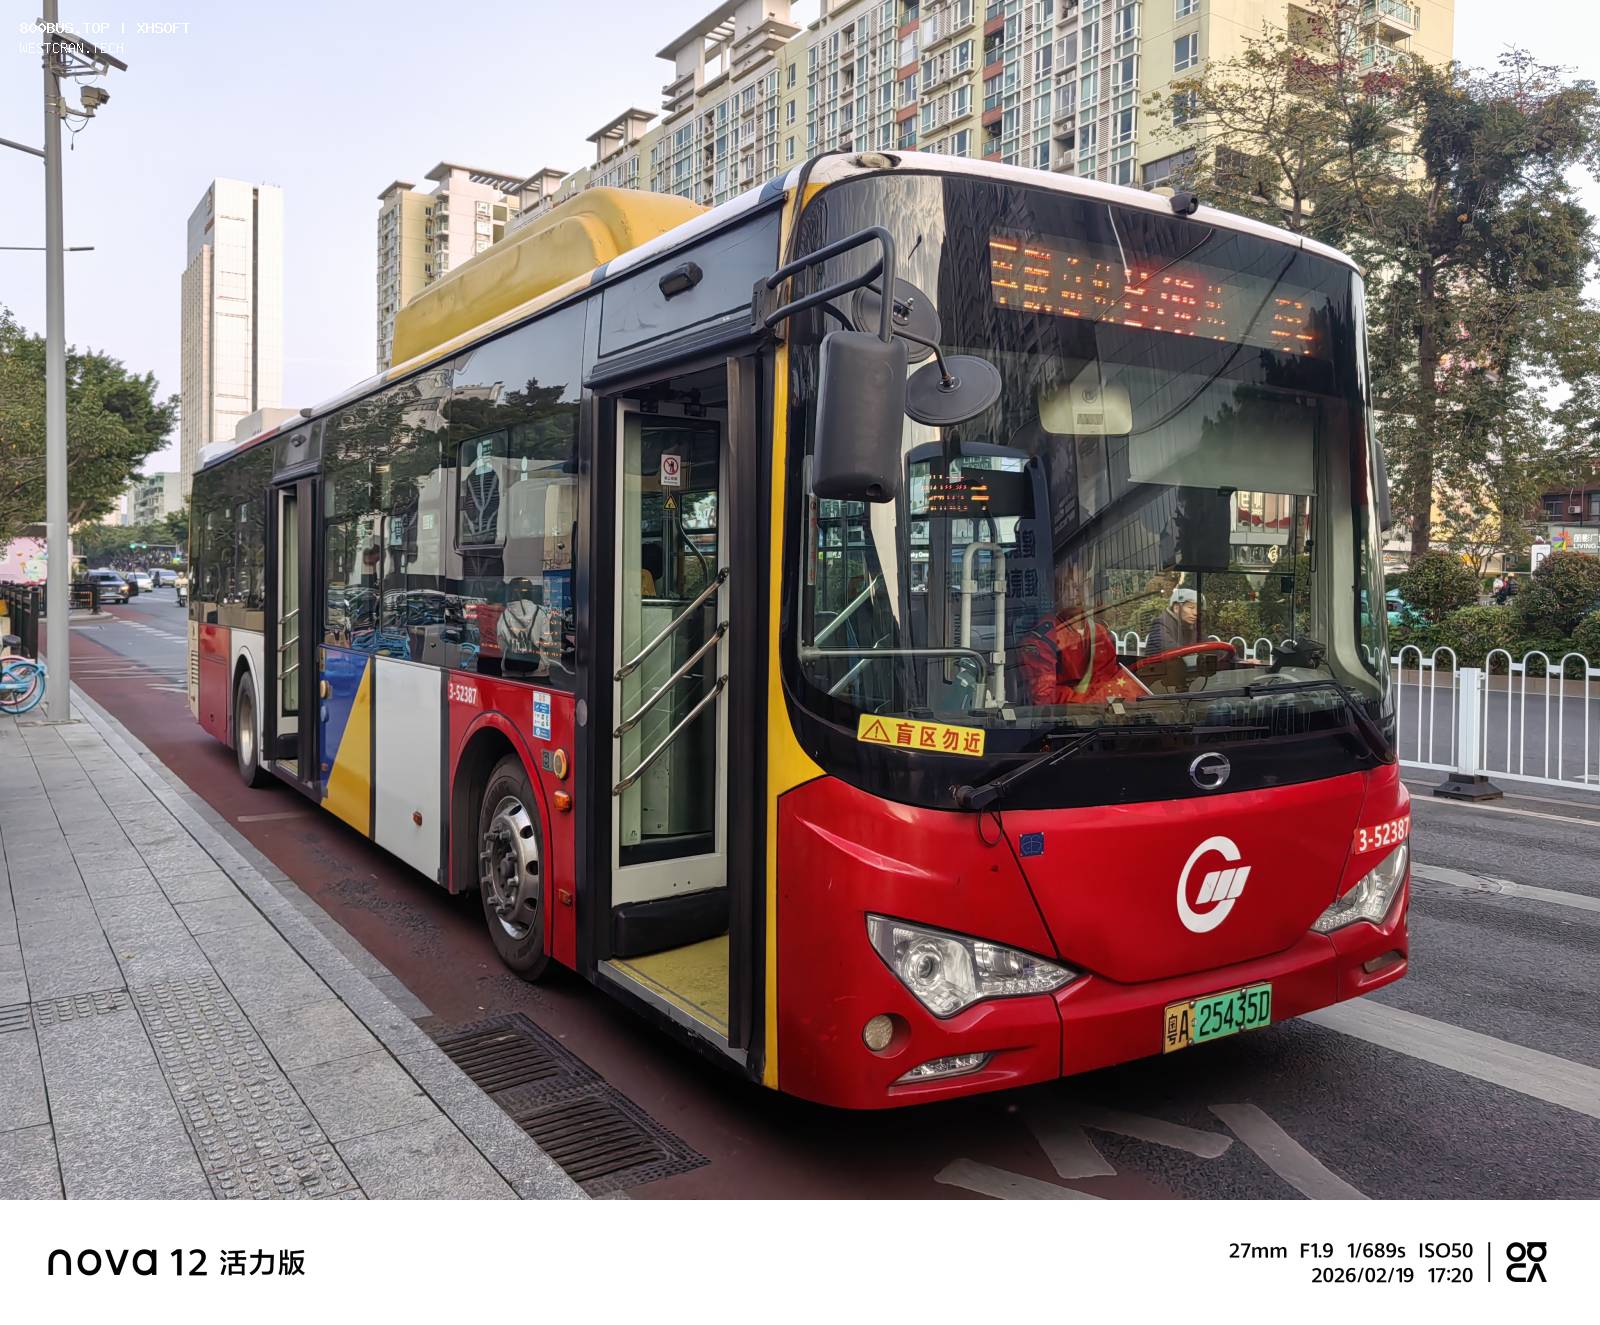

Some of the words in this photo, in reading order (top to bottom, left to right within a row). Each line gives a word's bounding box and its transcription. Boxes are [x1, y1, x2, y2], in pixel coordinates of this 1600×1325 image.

[449, 683, 477, 705] 3-52387
[896, 722, 980, 753] 盲区勿近
[1359, 817, 1410, 851] 3-52387
